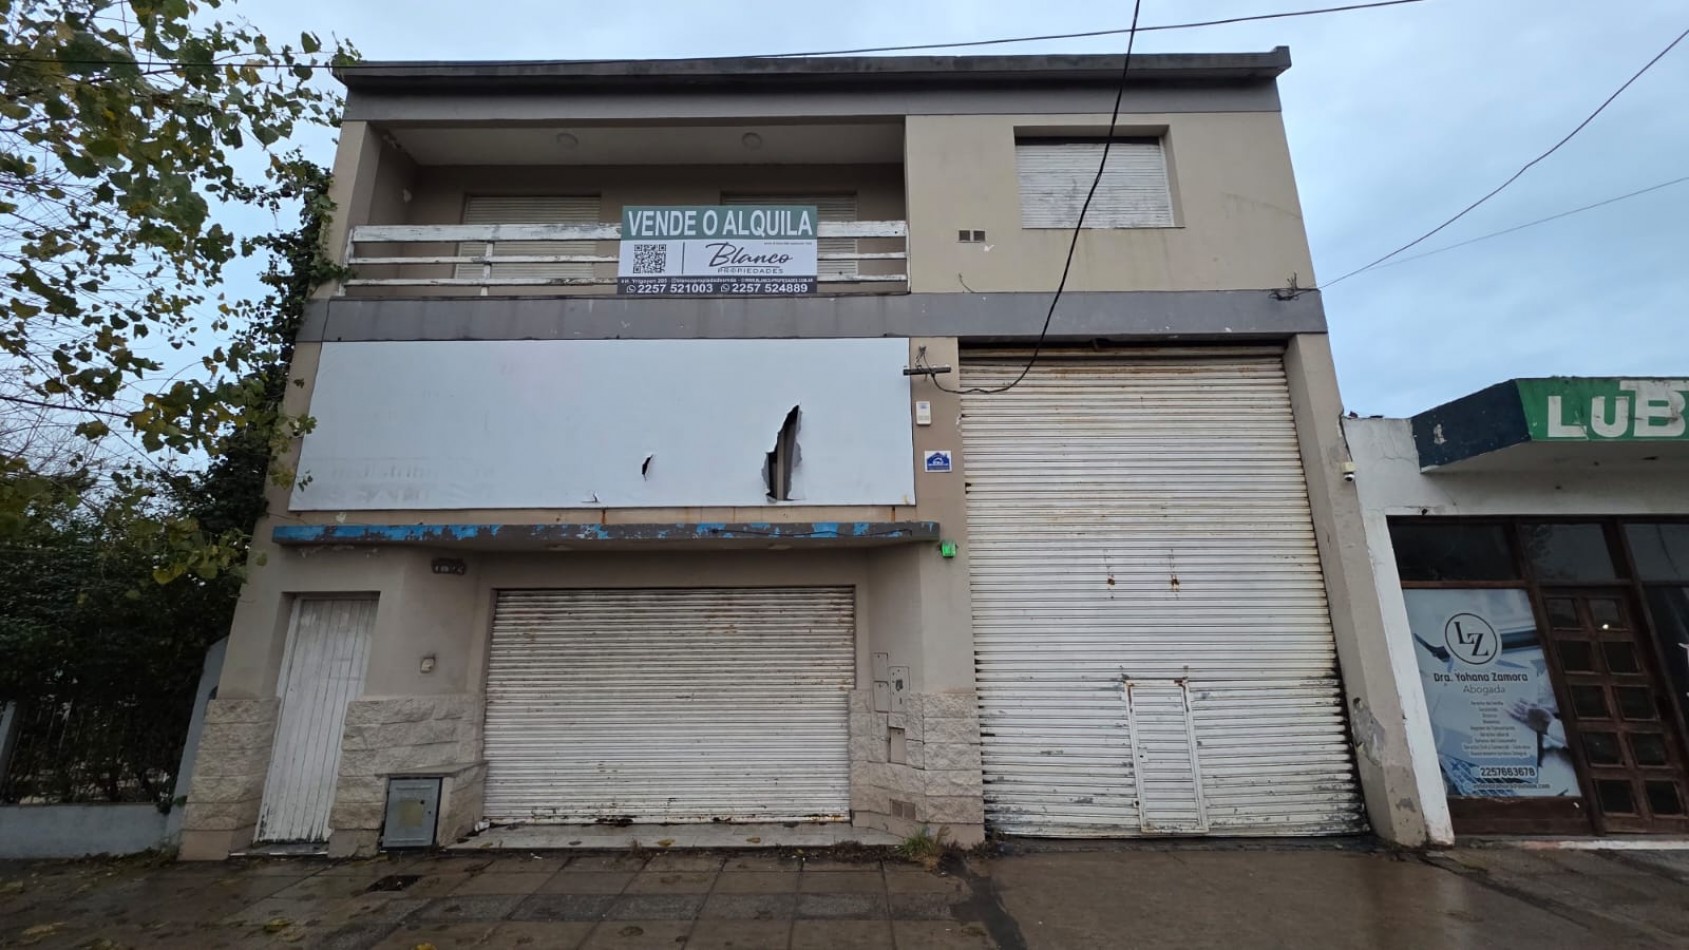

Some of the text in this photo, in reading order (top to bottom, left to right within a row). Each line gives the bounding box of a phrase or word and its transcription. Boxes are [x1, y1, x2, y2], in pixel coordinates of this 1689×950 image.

[628, 210, 813, 238] VENDE O ALQUILA
[705, 241, 793, 267] Blanco
[637, 284, 714, 293] 2257 521003
[731, 283, 808, 293] 2257 524889
[1433, 672, 1528, 682] Dra. Yohana Zamora
[1463, 684, 1506, 695] Abogada
